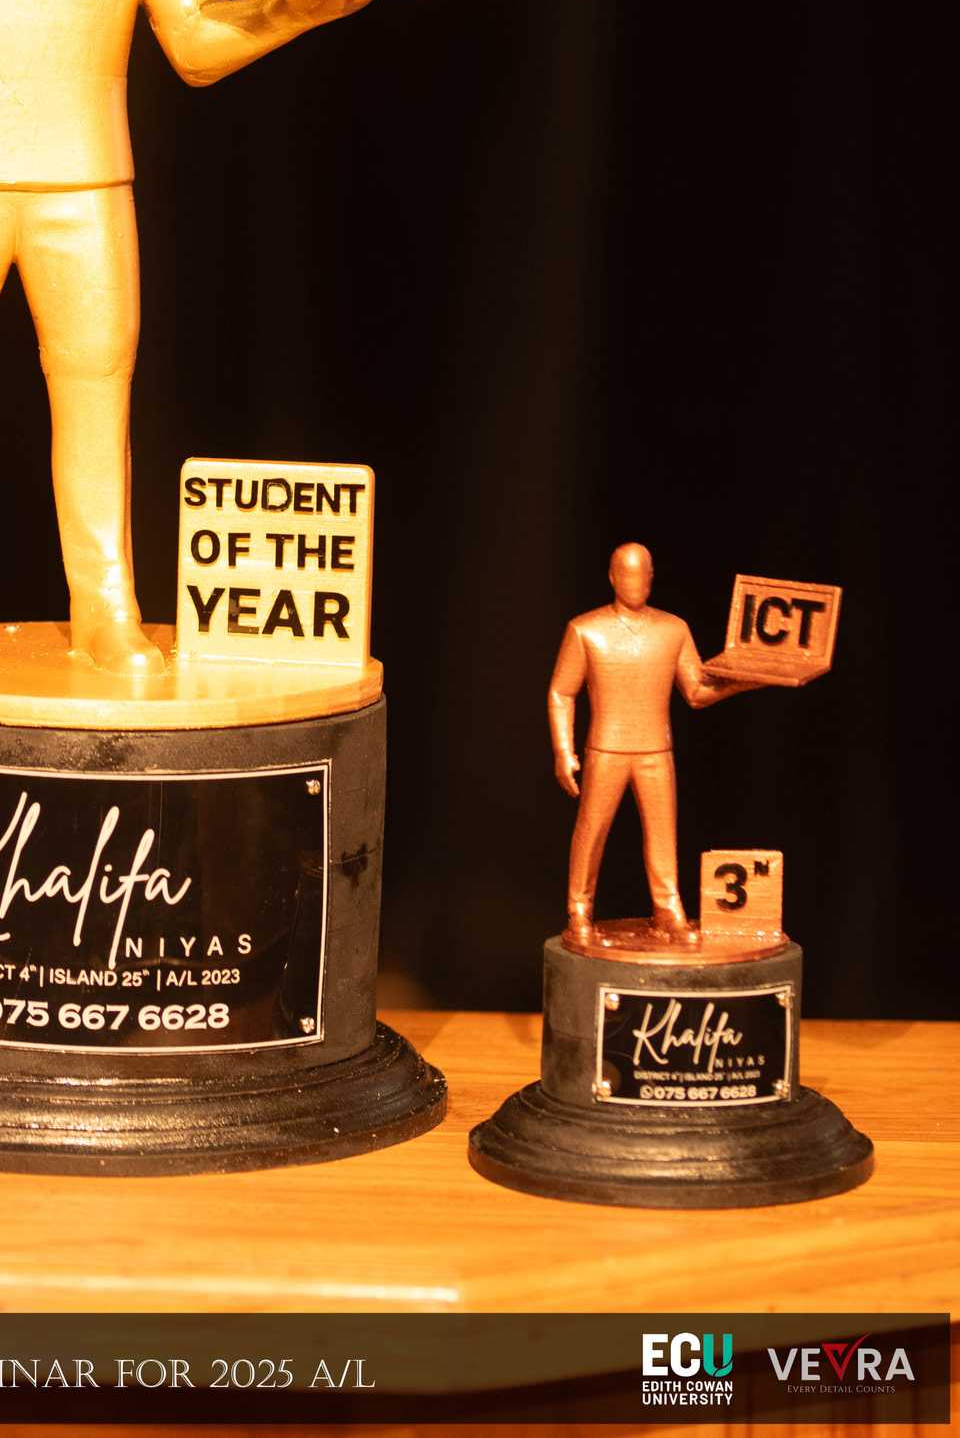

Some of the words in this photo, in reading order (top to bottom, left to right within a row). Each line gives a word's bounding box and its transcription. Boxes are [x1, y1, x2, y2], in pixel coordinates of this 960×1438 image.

[184, 477, 366, 515] STUDENT
[191, 529, 251, 567] OF
[266, 533, 356, 570] THE
[187, 585, 351, 639] YEAR
[741, 594, 827, 649] ICT
[125, 934, 253, 959] NIYAS
[49, 968, 118, 987] ISLAND
[166, 970, 198, 987] A/L
[201, 968, 241, 986] 2023
[58, 1003, 130, 1031] 667
[138, 1003, 230, 1031] 6628
[632, 998, 743, 1073] Khalifa
